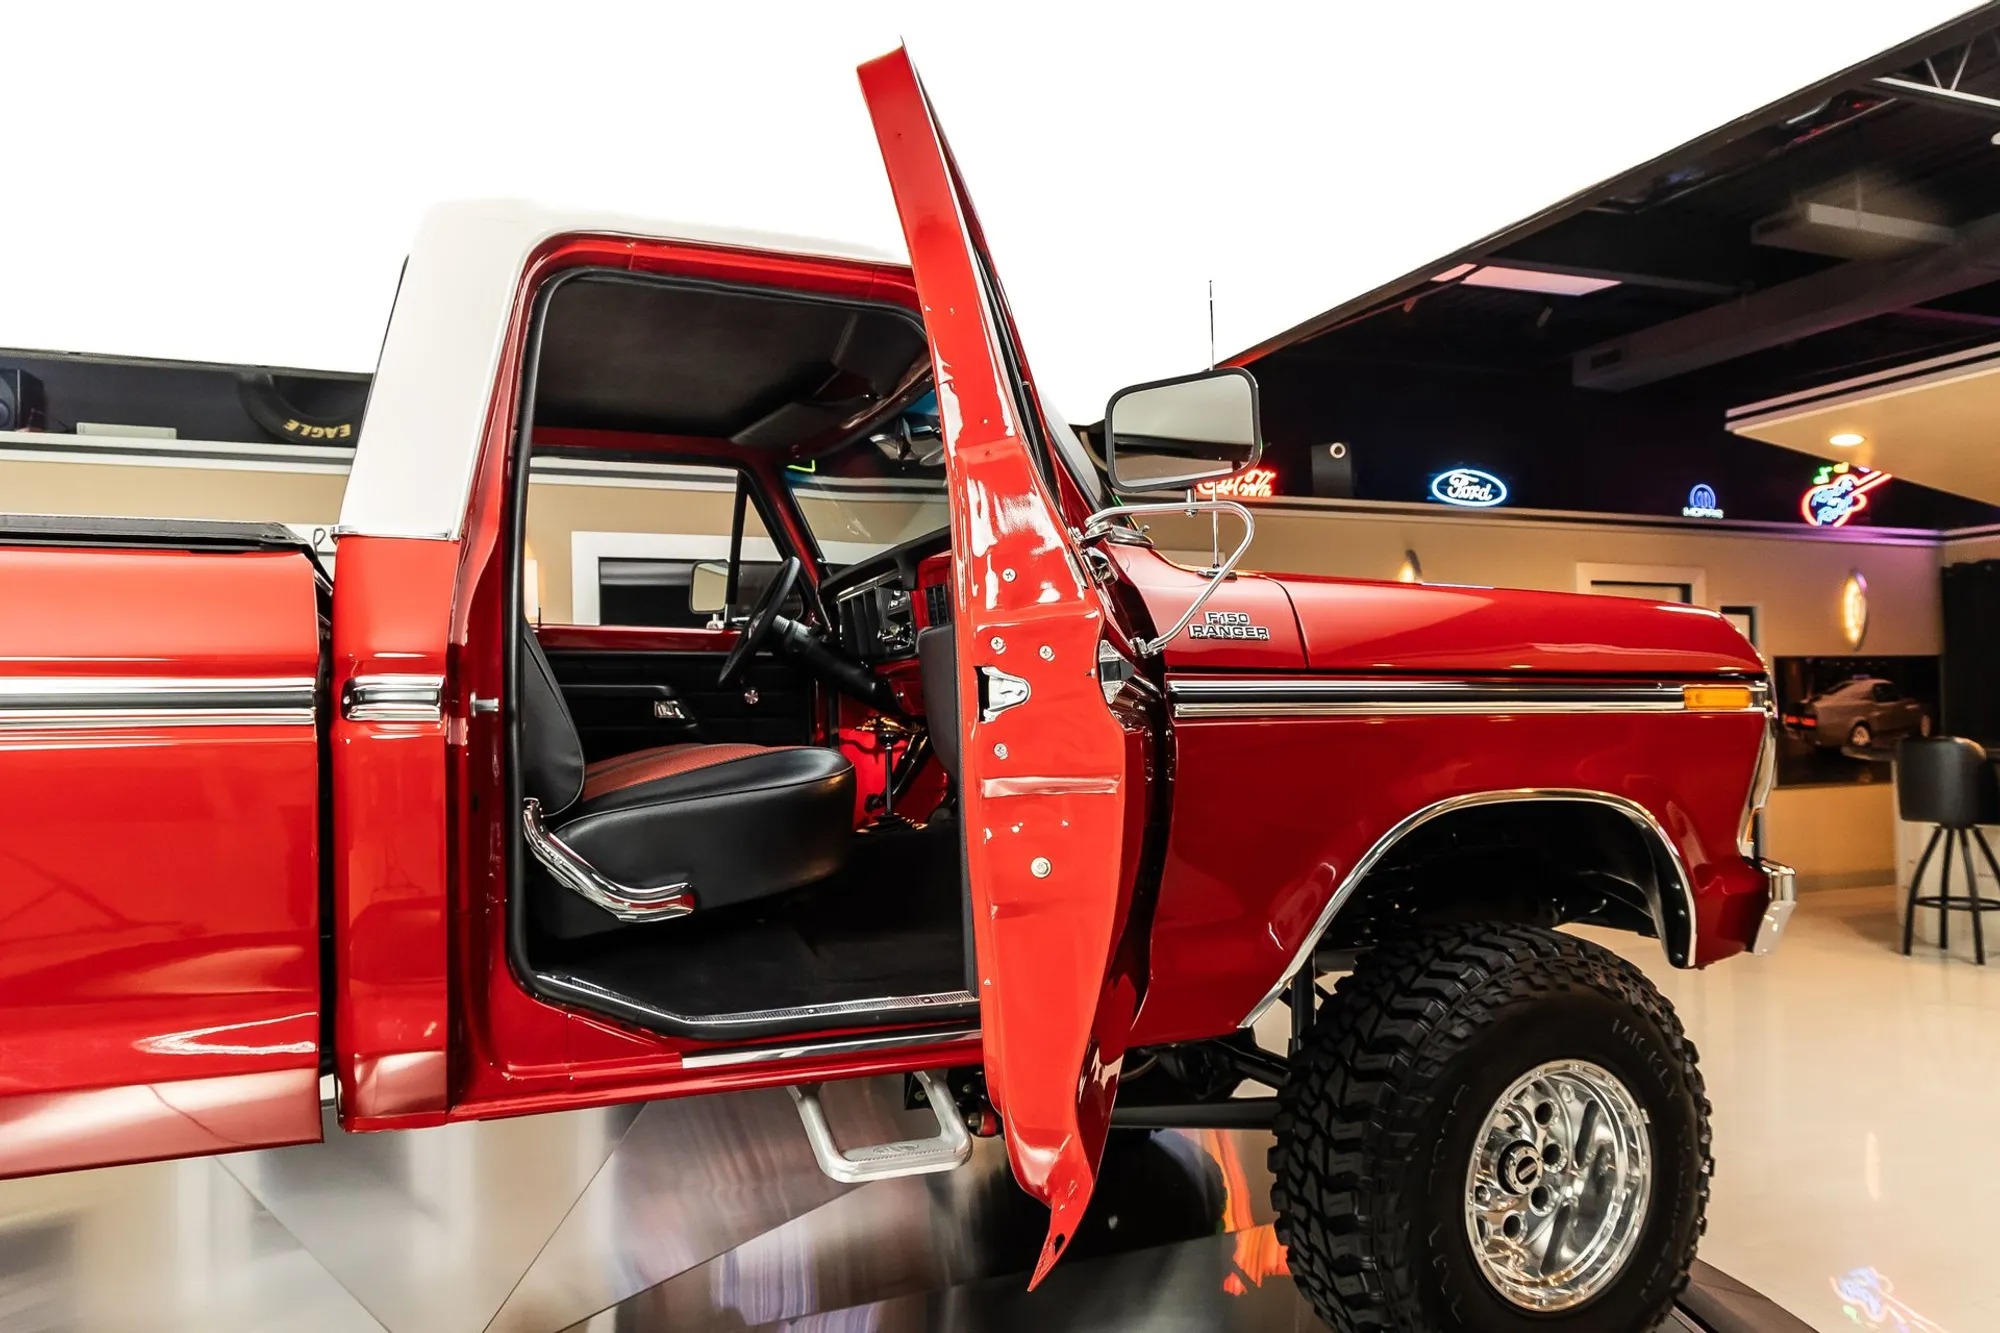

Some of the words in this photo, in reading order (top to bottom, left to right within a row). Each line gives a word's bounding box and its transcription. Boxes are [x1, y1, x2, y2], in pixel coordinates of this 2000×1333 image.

[283, 419, 351, 438] EAGLE
[1447, 473, 1493, 500] Ford
[1204, 611, 1250, 625] F150
[1188, 624, 1270, 640] RANGER
